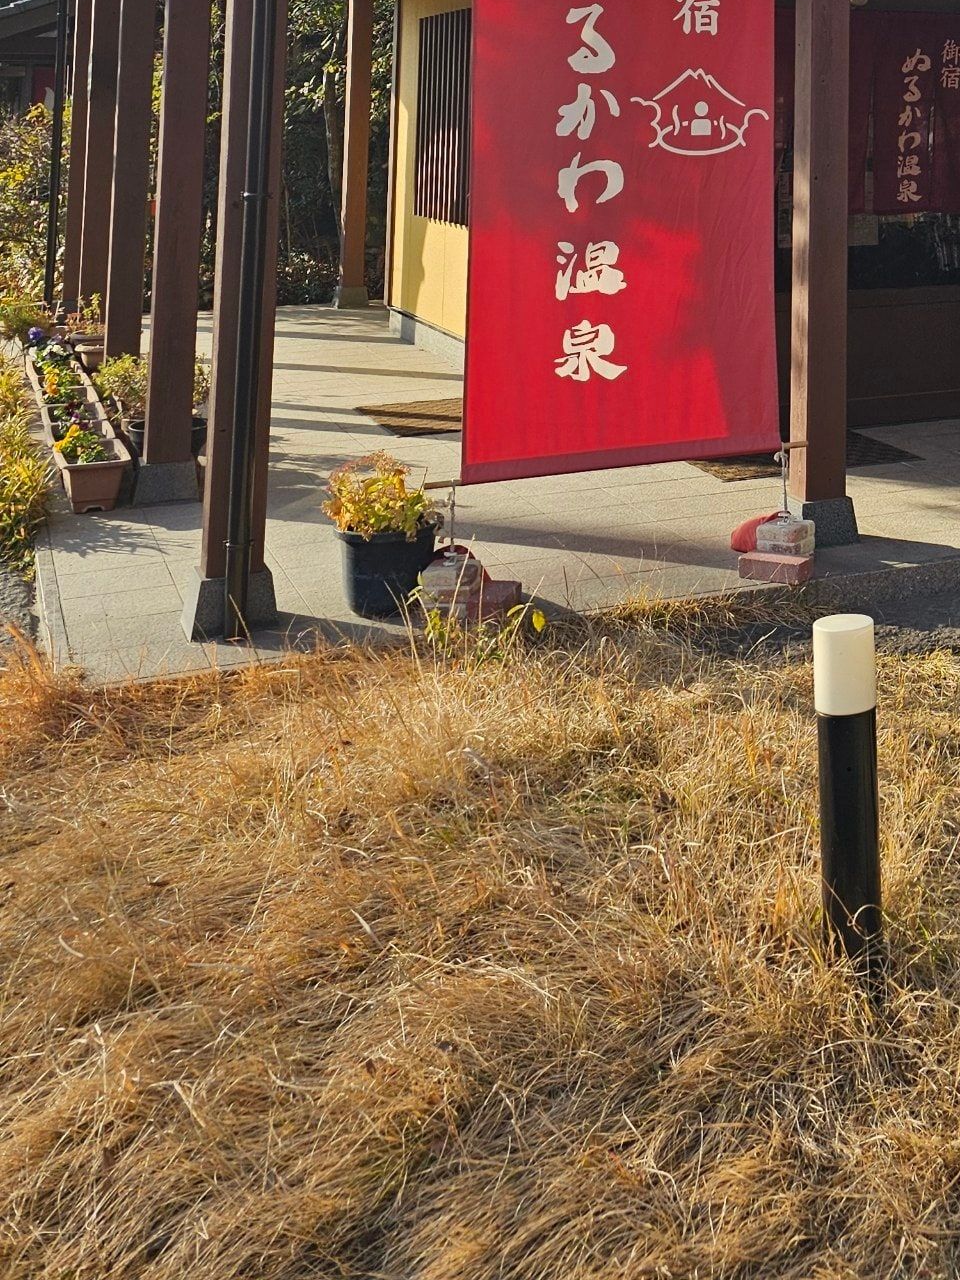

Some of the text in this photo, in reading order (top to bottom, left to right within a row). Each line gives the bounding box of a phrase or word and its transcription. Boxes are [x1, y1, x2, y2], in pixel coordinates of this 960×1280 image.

[897, 48, 931, 203] ぬるかわ温泉
